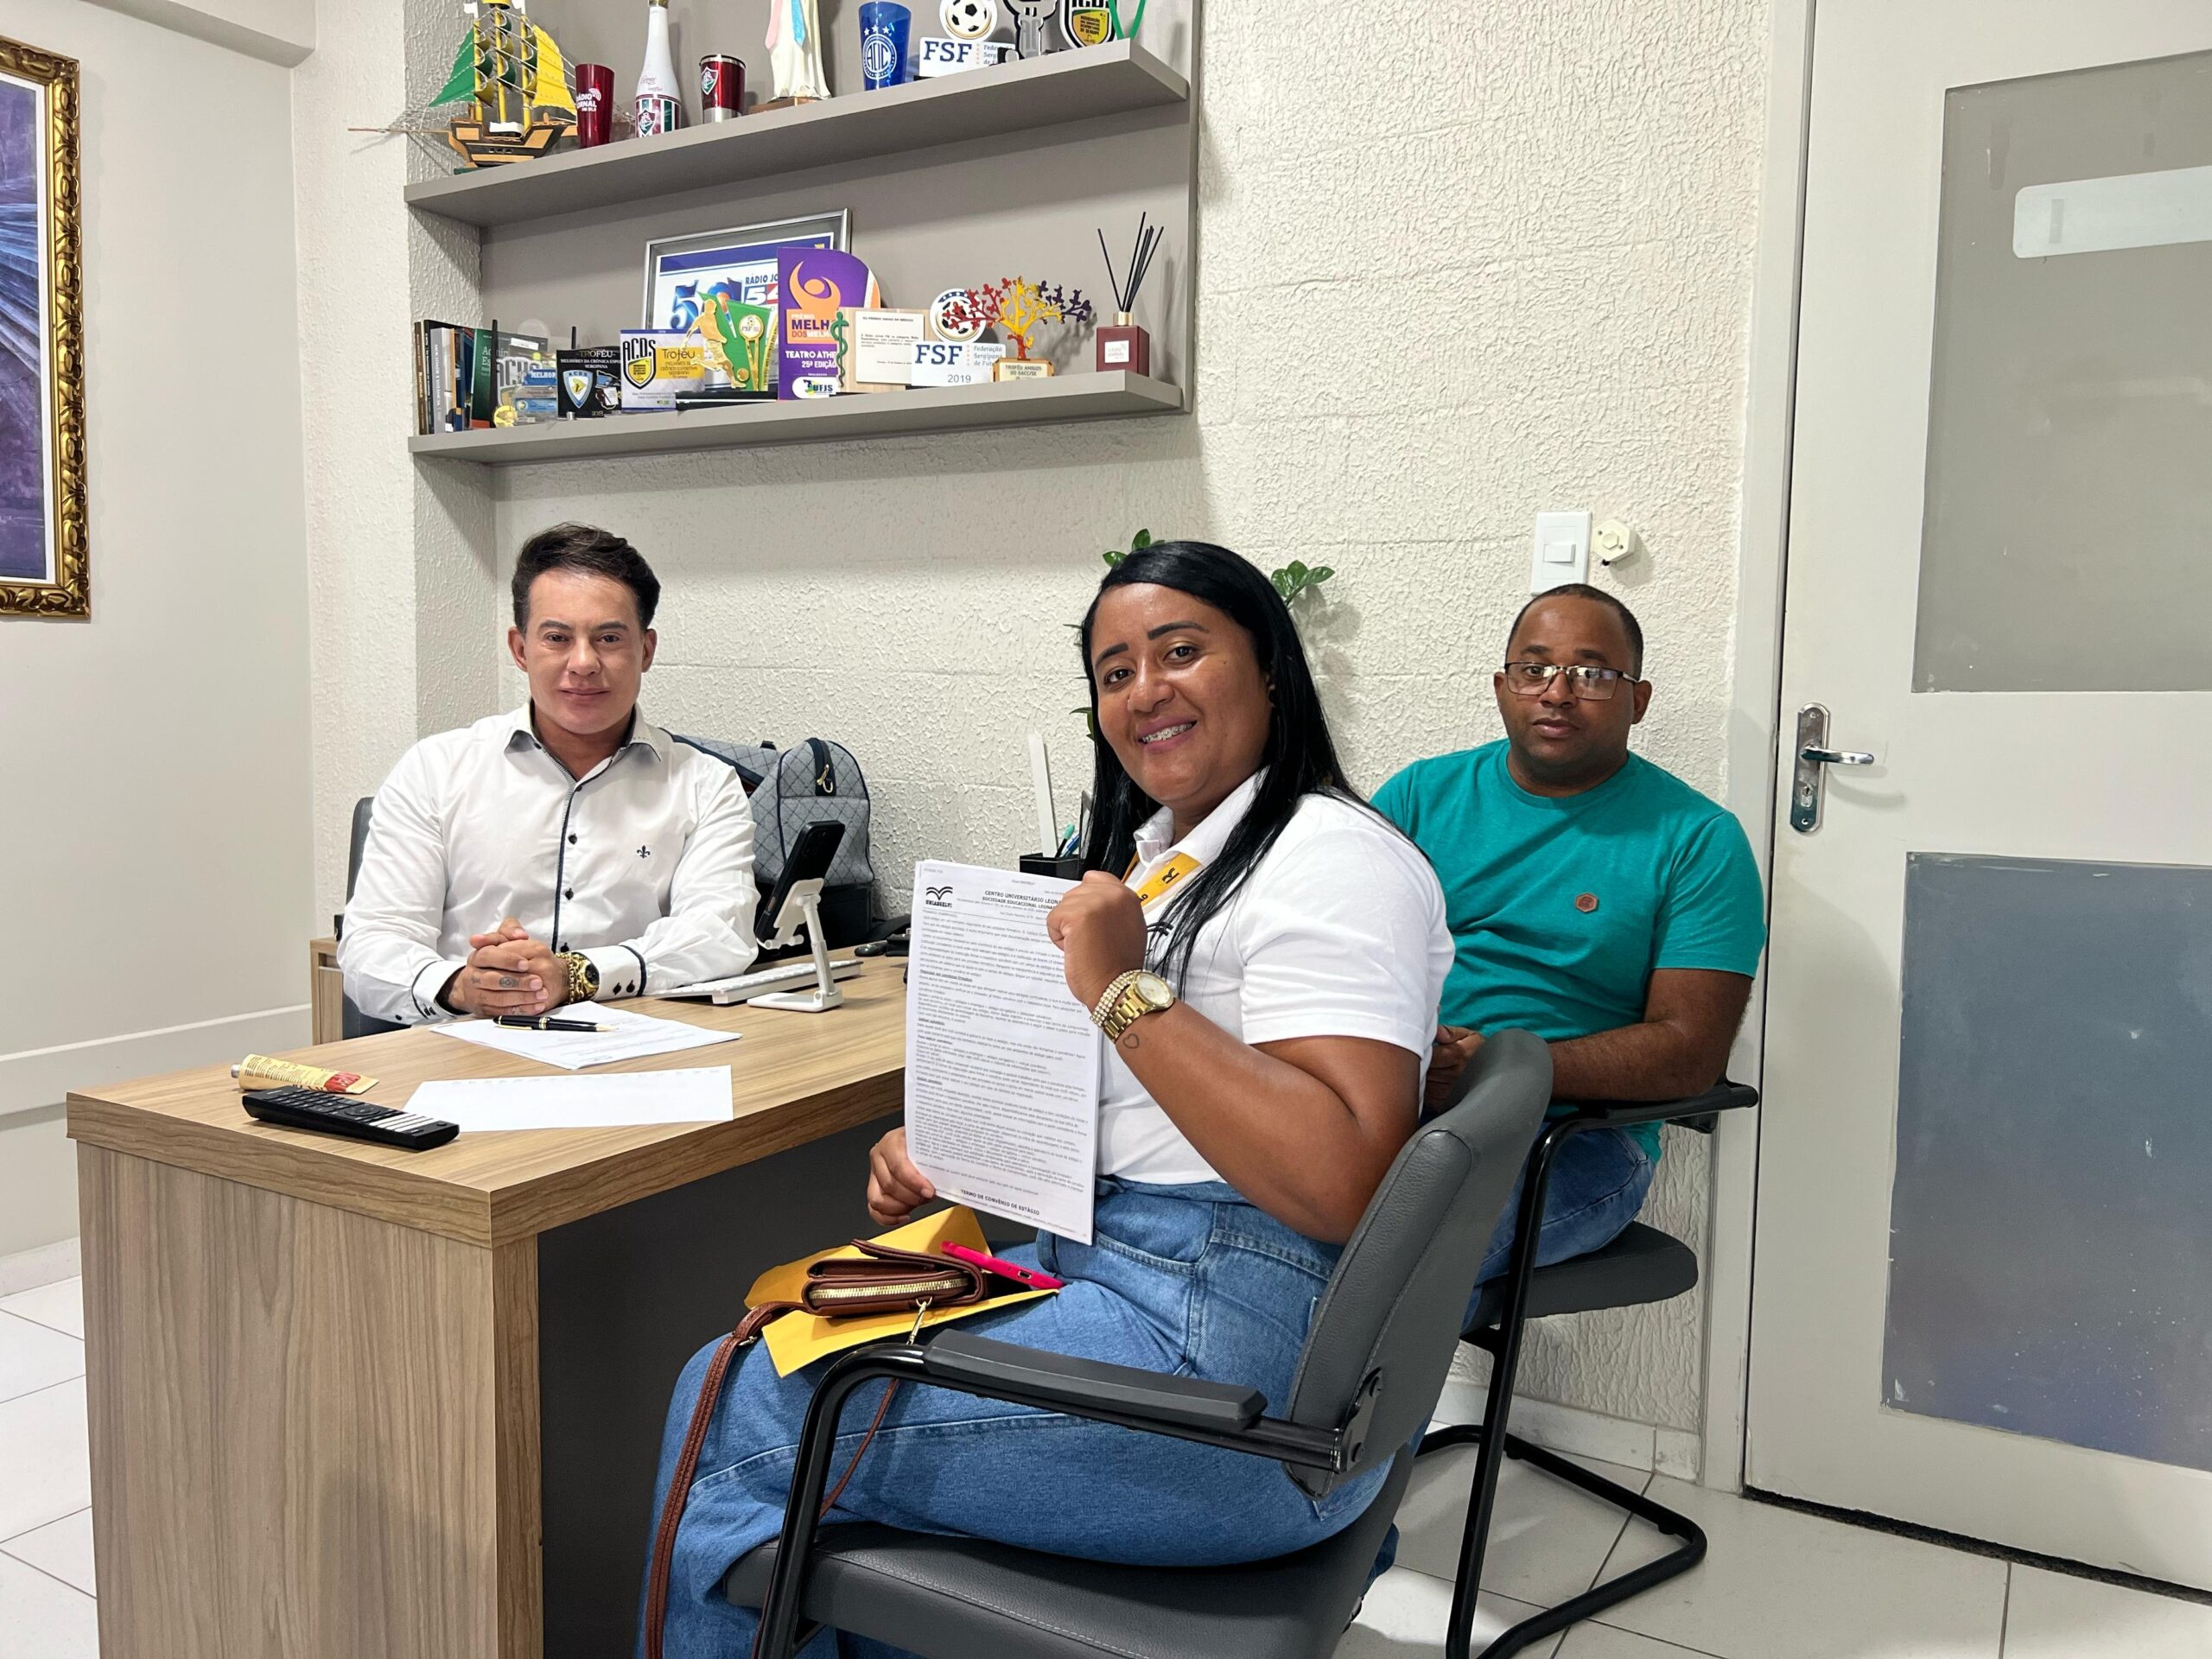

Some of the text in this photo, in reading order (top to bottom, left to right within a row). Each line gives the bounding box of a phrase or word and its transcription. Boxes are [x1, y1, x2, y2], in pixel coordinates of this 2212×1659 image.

[923, 41, 972, 63] FSF
[576, 100, 597, 110] ORNAL
[746, 273, 779, 285] RÁDIO JO
[744, 285, 779, 306] 54
[791, 319, 830, 330] MELH
[622, 338, 657, 361] ACDS
[662, 348, 696, 361] Troféu
[785, 350, 836, 359] TEATRO ATHE
[914, 344, 963, 365] FSF
[947, 374, 972, 384] 2019
[1005, 893, 1044, 903] UNIVERSITÁRIO
[1007, 899, 1037, 908] EDUCACIONAL
[961, 1189, 978, 1198] TERMO
[985, 1195, 1010, 1208] CONVÊNIO
[1018, 1204, 1040, 1216] ESTÁGIO
